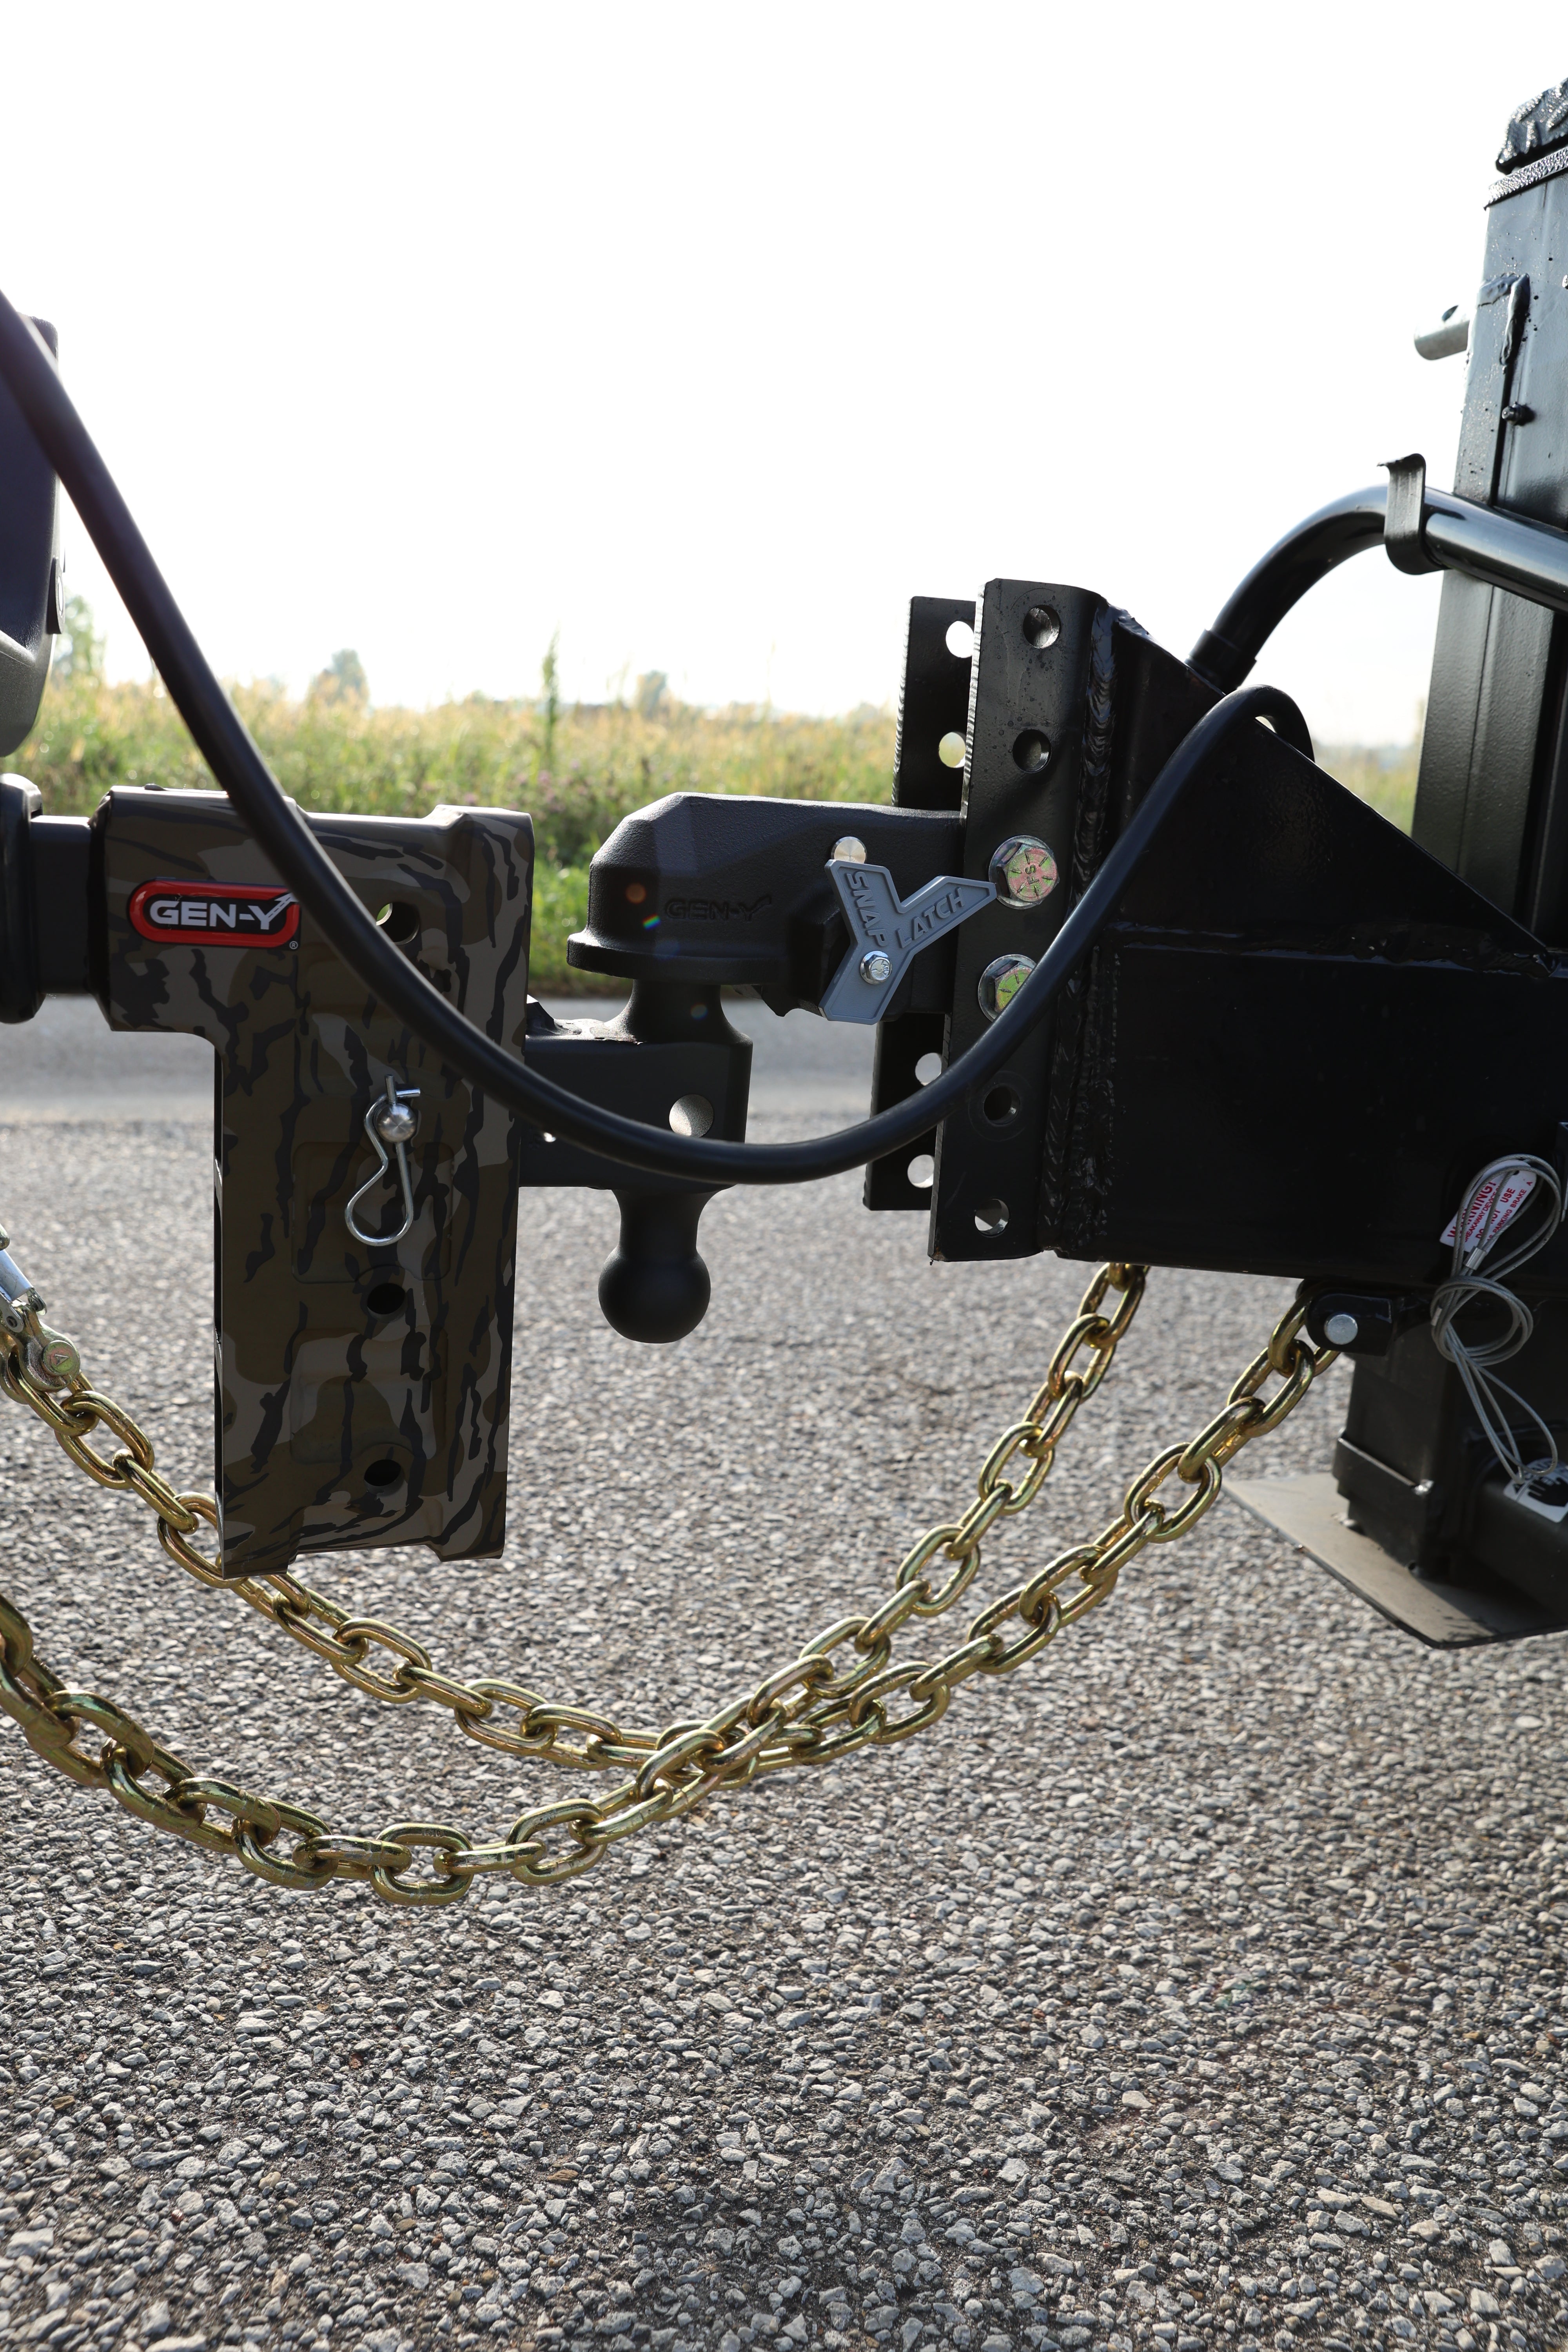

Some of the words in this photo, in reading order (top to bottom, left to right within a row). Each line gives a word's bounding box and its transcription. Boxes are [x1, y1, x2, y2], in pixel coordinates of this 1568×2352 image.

[150, 892, 299, 930] GEN-Y
[665, 893, 771, 922] GEN-Y
[845, 870, 890, 947] SNAP
[895, 887, 965, 948] LATCH
[1493, 1209, 1512, 1233] PARKING
[1510, 1189, 1527, 1208] BRAKE
[1500, 1188, 1515, 1203] USE
